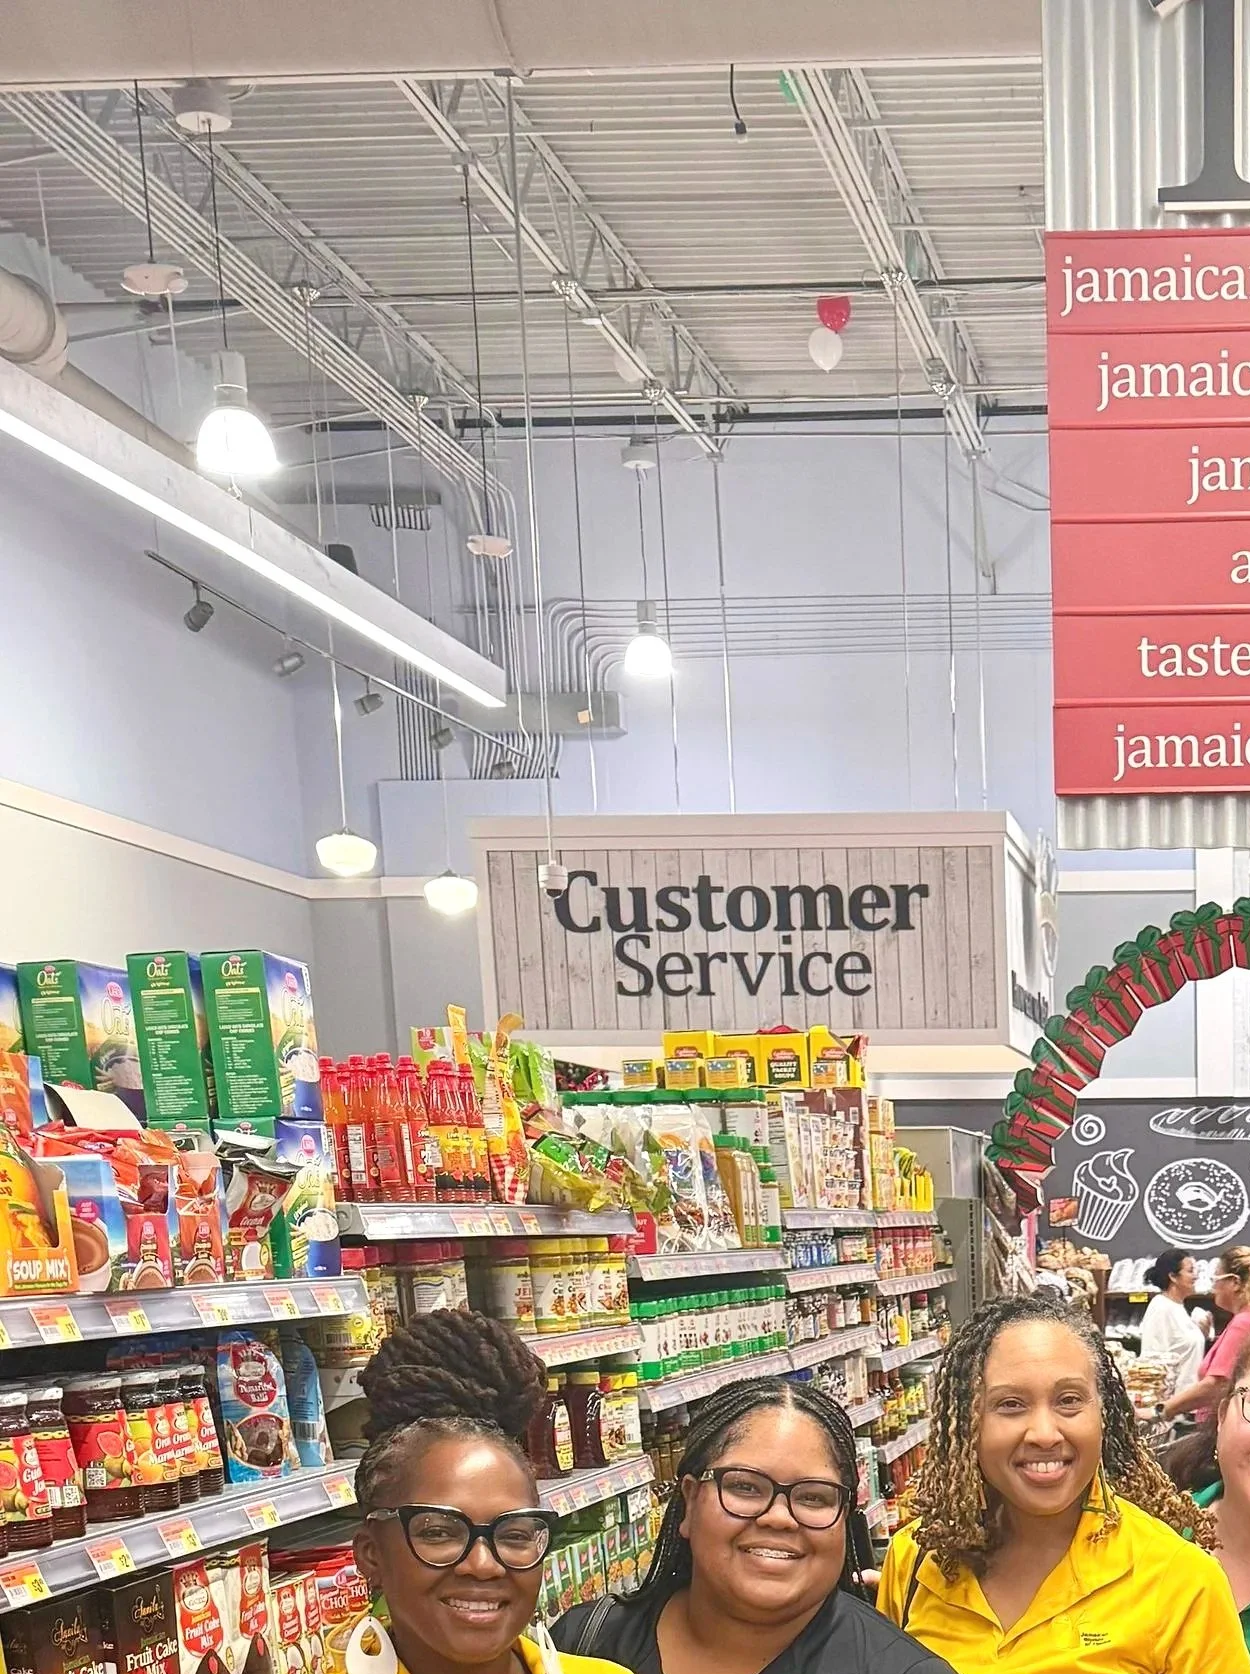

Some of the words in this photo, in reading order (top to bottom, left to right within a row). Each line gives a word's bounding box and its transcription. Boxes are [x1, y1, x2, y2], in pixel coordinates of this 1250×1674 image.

[553, 870, 929, 934] Customer
[614, 934, 873, 998] Service
[13, 1260, 43, 1281] SOUP
[46, 1258, 69, 1279] MIX
[126, 1647, 154, 1673] Fruit
[154, 1637, 179, 1661] Cake
